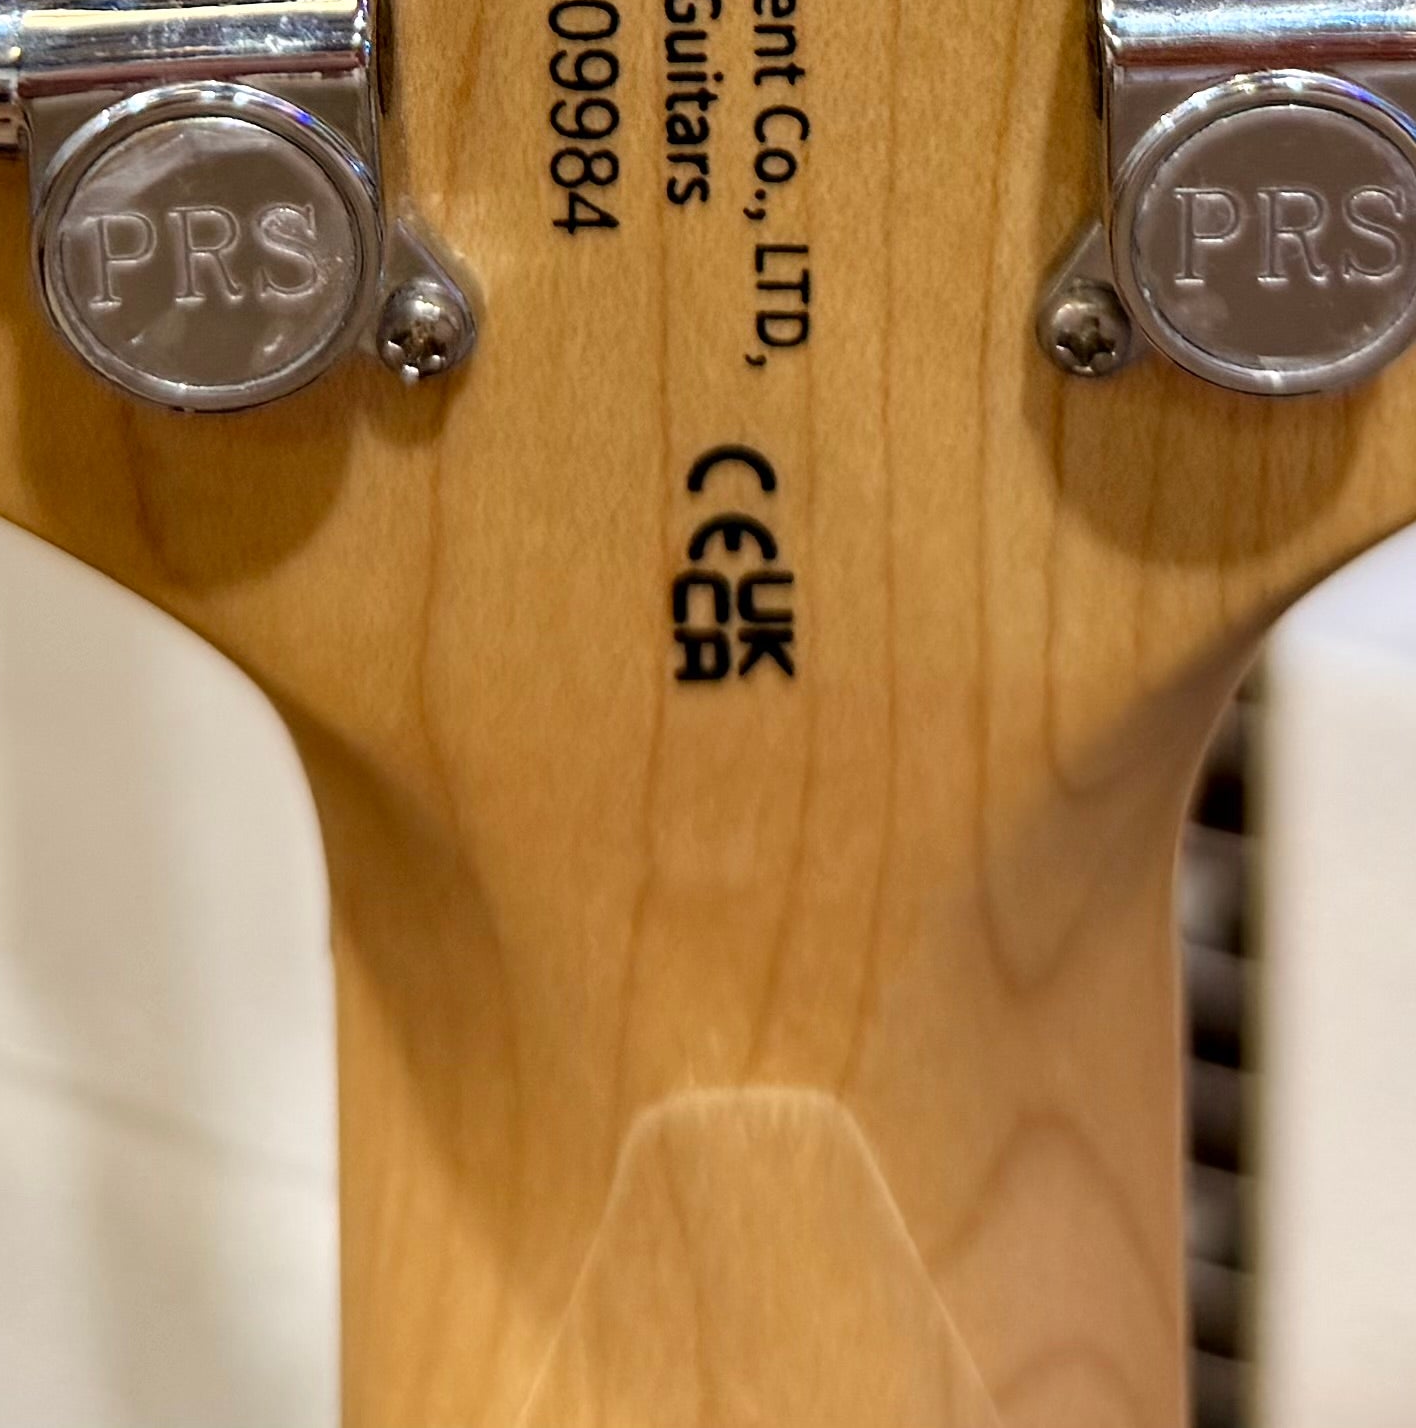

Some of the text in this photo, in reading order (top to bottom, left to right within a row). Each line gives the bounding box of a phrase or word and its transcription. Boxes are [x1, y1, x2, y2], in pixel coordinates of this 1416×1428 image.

[742, 104, 812, 222] Co.,
[80, 203, 321, 309] PRS
[1174, 182, 1408, 286] PRS
[744, 243, 812, 368] LTD,
[670, 568, 732, 682] CA
[734, 569, 796, 679] UK
